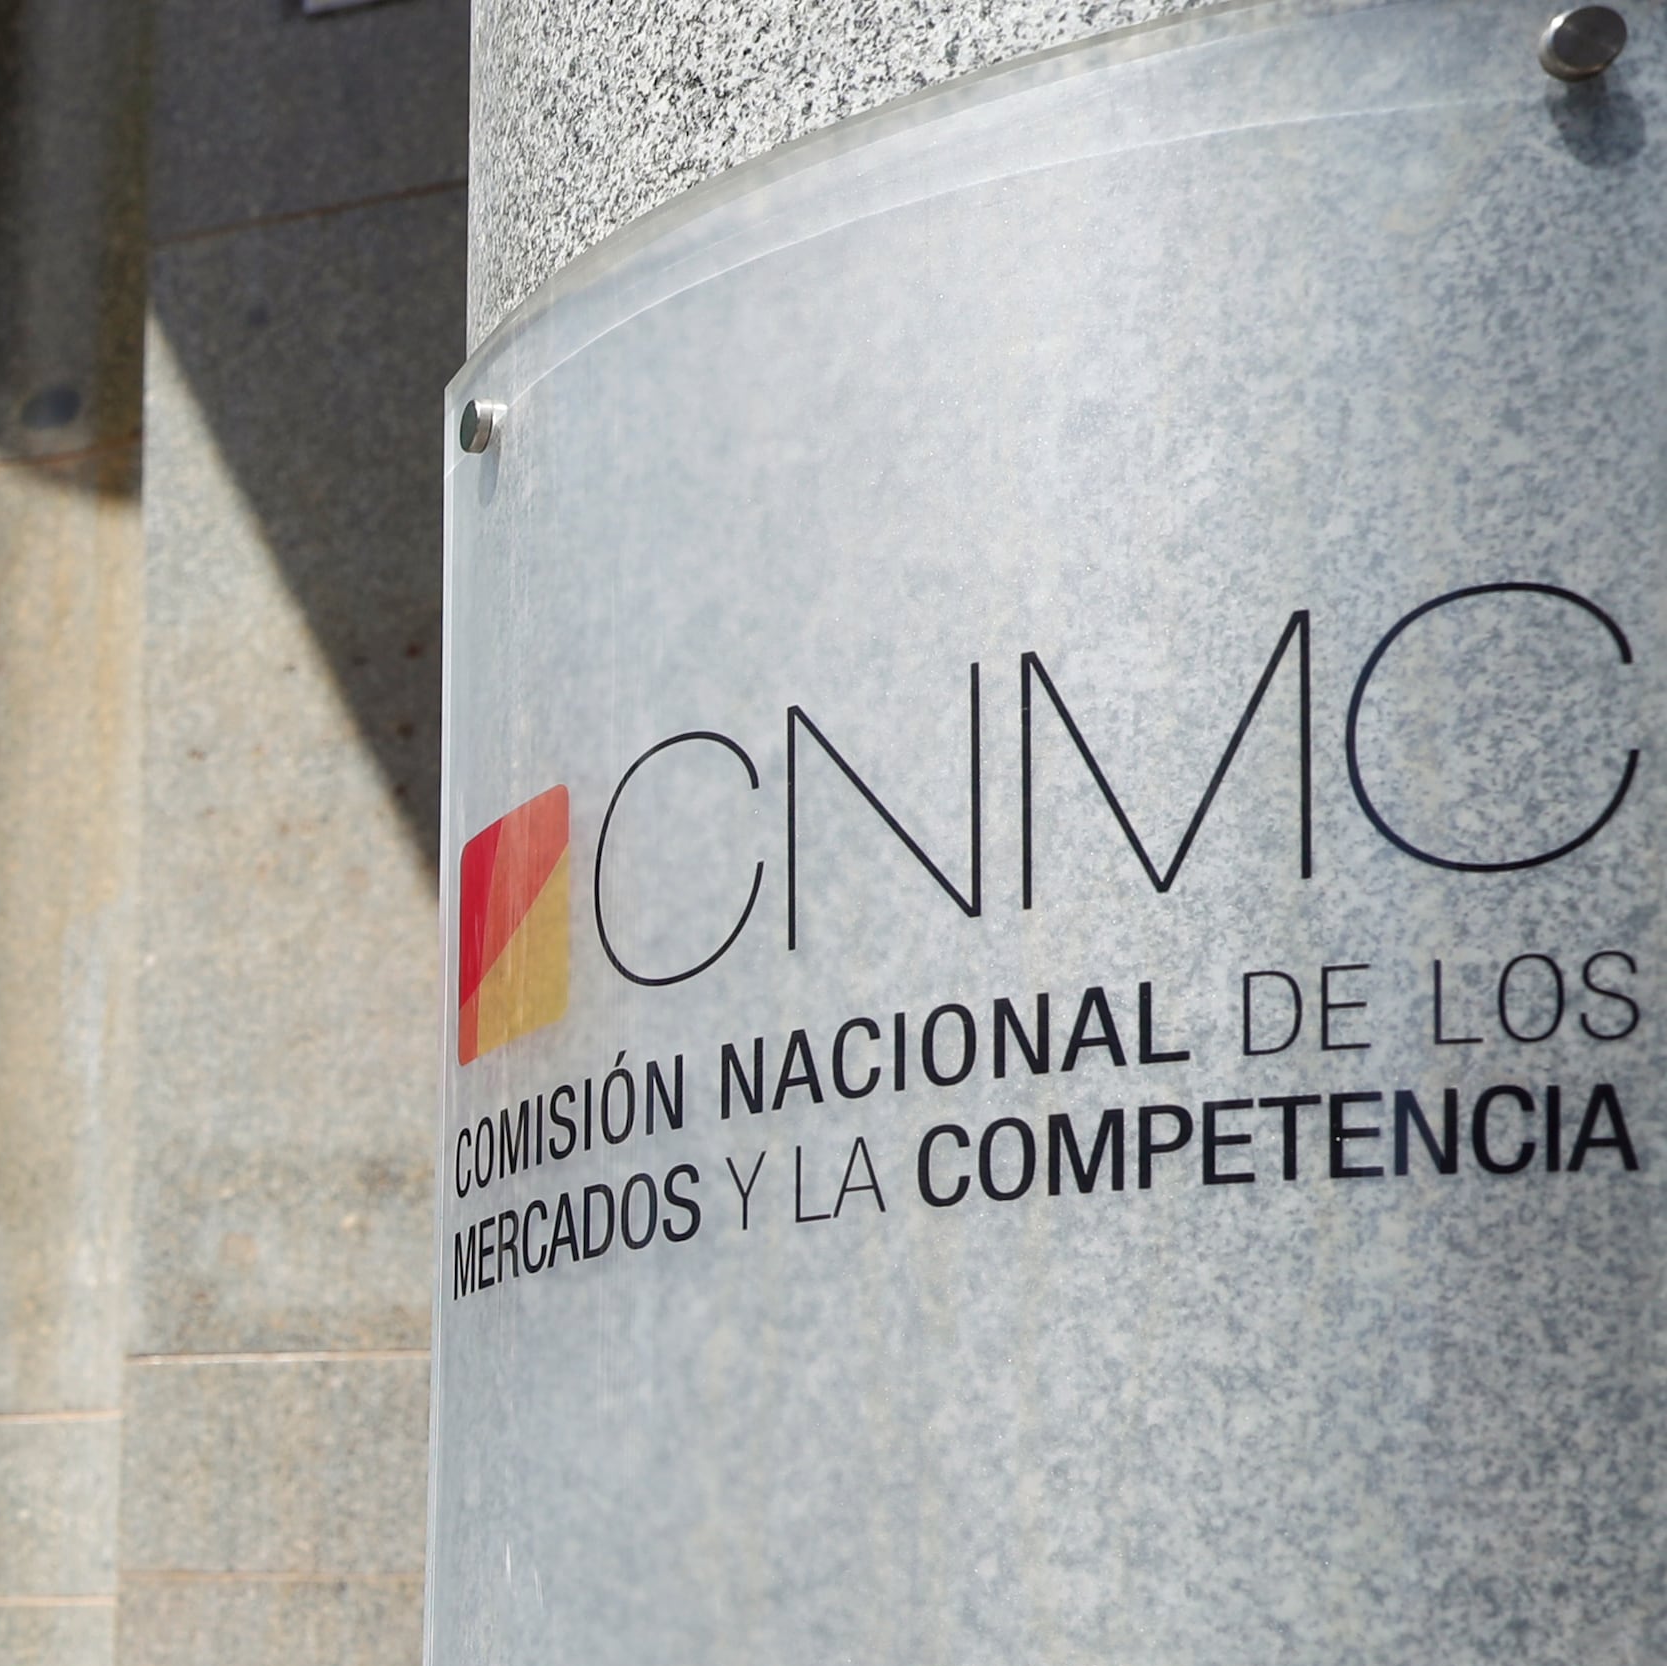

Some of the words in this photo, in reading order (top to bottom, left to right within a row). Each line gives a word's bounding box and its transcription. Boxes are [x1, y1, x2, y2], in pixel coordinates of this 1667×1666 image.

[592, 580, 1641, 988] CNMC
[453, 1163, 702, 1301] MERCADOS
[725, 1150, 767, 1231] Y
[795, 1135, 887, 1224] LA
[917, 1083, 1640, 1208] COMPETENCIA
[454, 1049, 685, 1199] COMISIÓN
[720, 980, 1191, 1120] NACIONAL
[1242, 963, 1372, 1057] DE
[1433, 950, 1641, 1046] LOS
